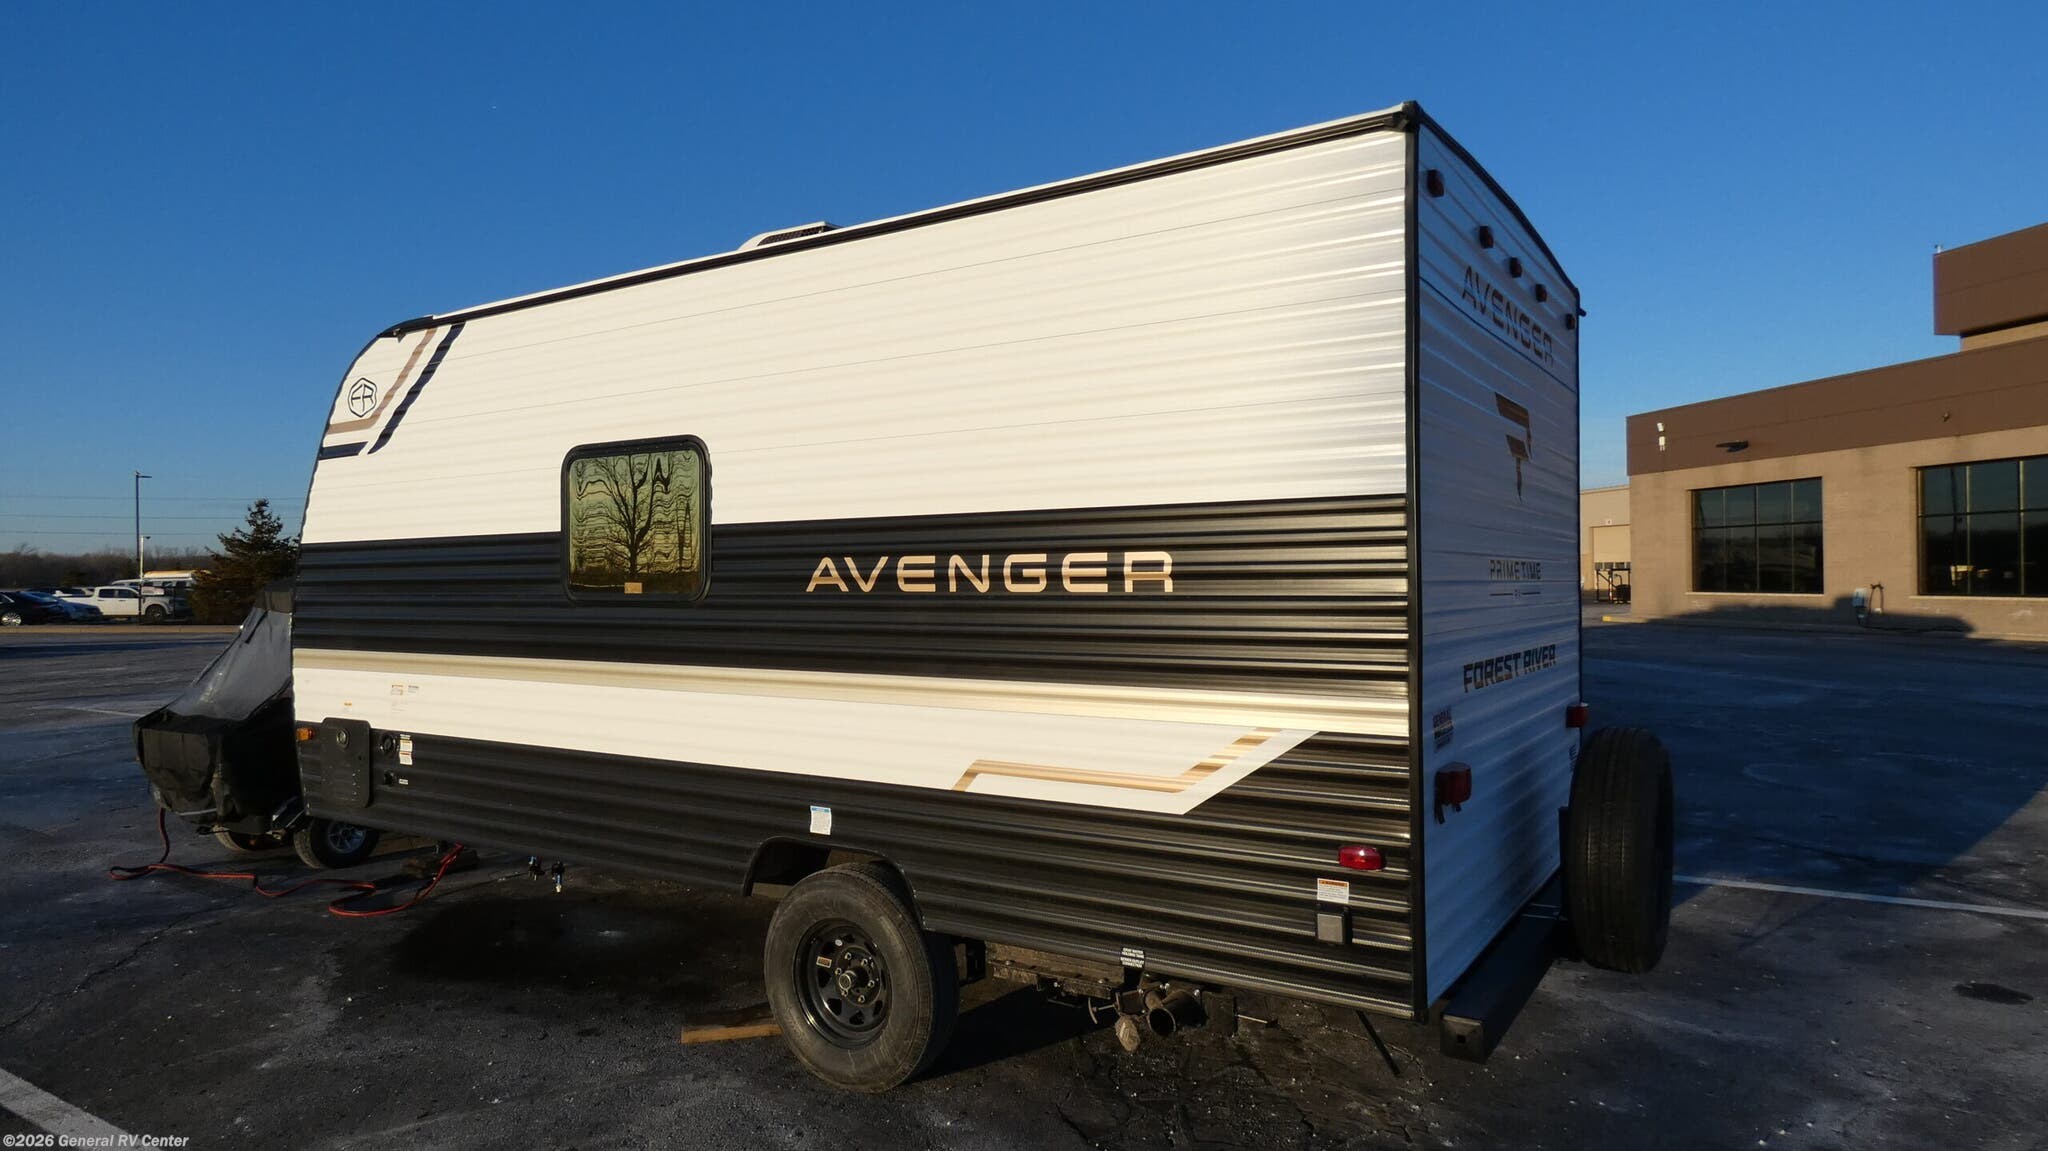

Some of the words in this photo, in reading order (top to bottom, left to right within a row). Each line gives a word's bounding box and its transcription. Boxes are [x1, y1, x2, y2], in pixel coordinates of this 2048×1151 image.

[1462, 265, 1554, 368] AVENGER
[805, 551, 1174, 593] AVENGER
[1463, 652, 1521, 693] FOREST
[1523, 643, 1556, 675] RIVER
